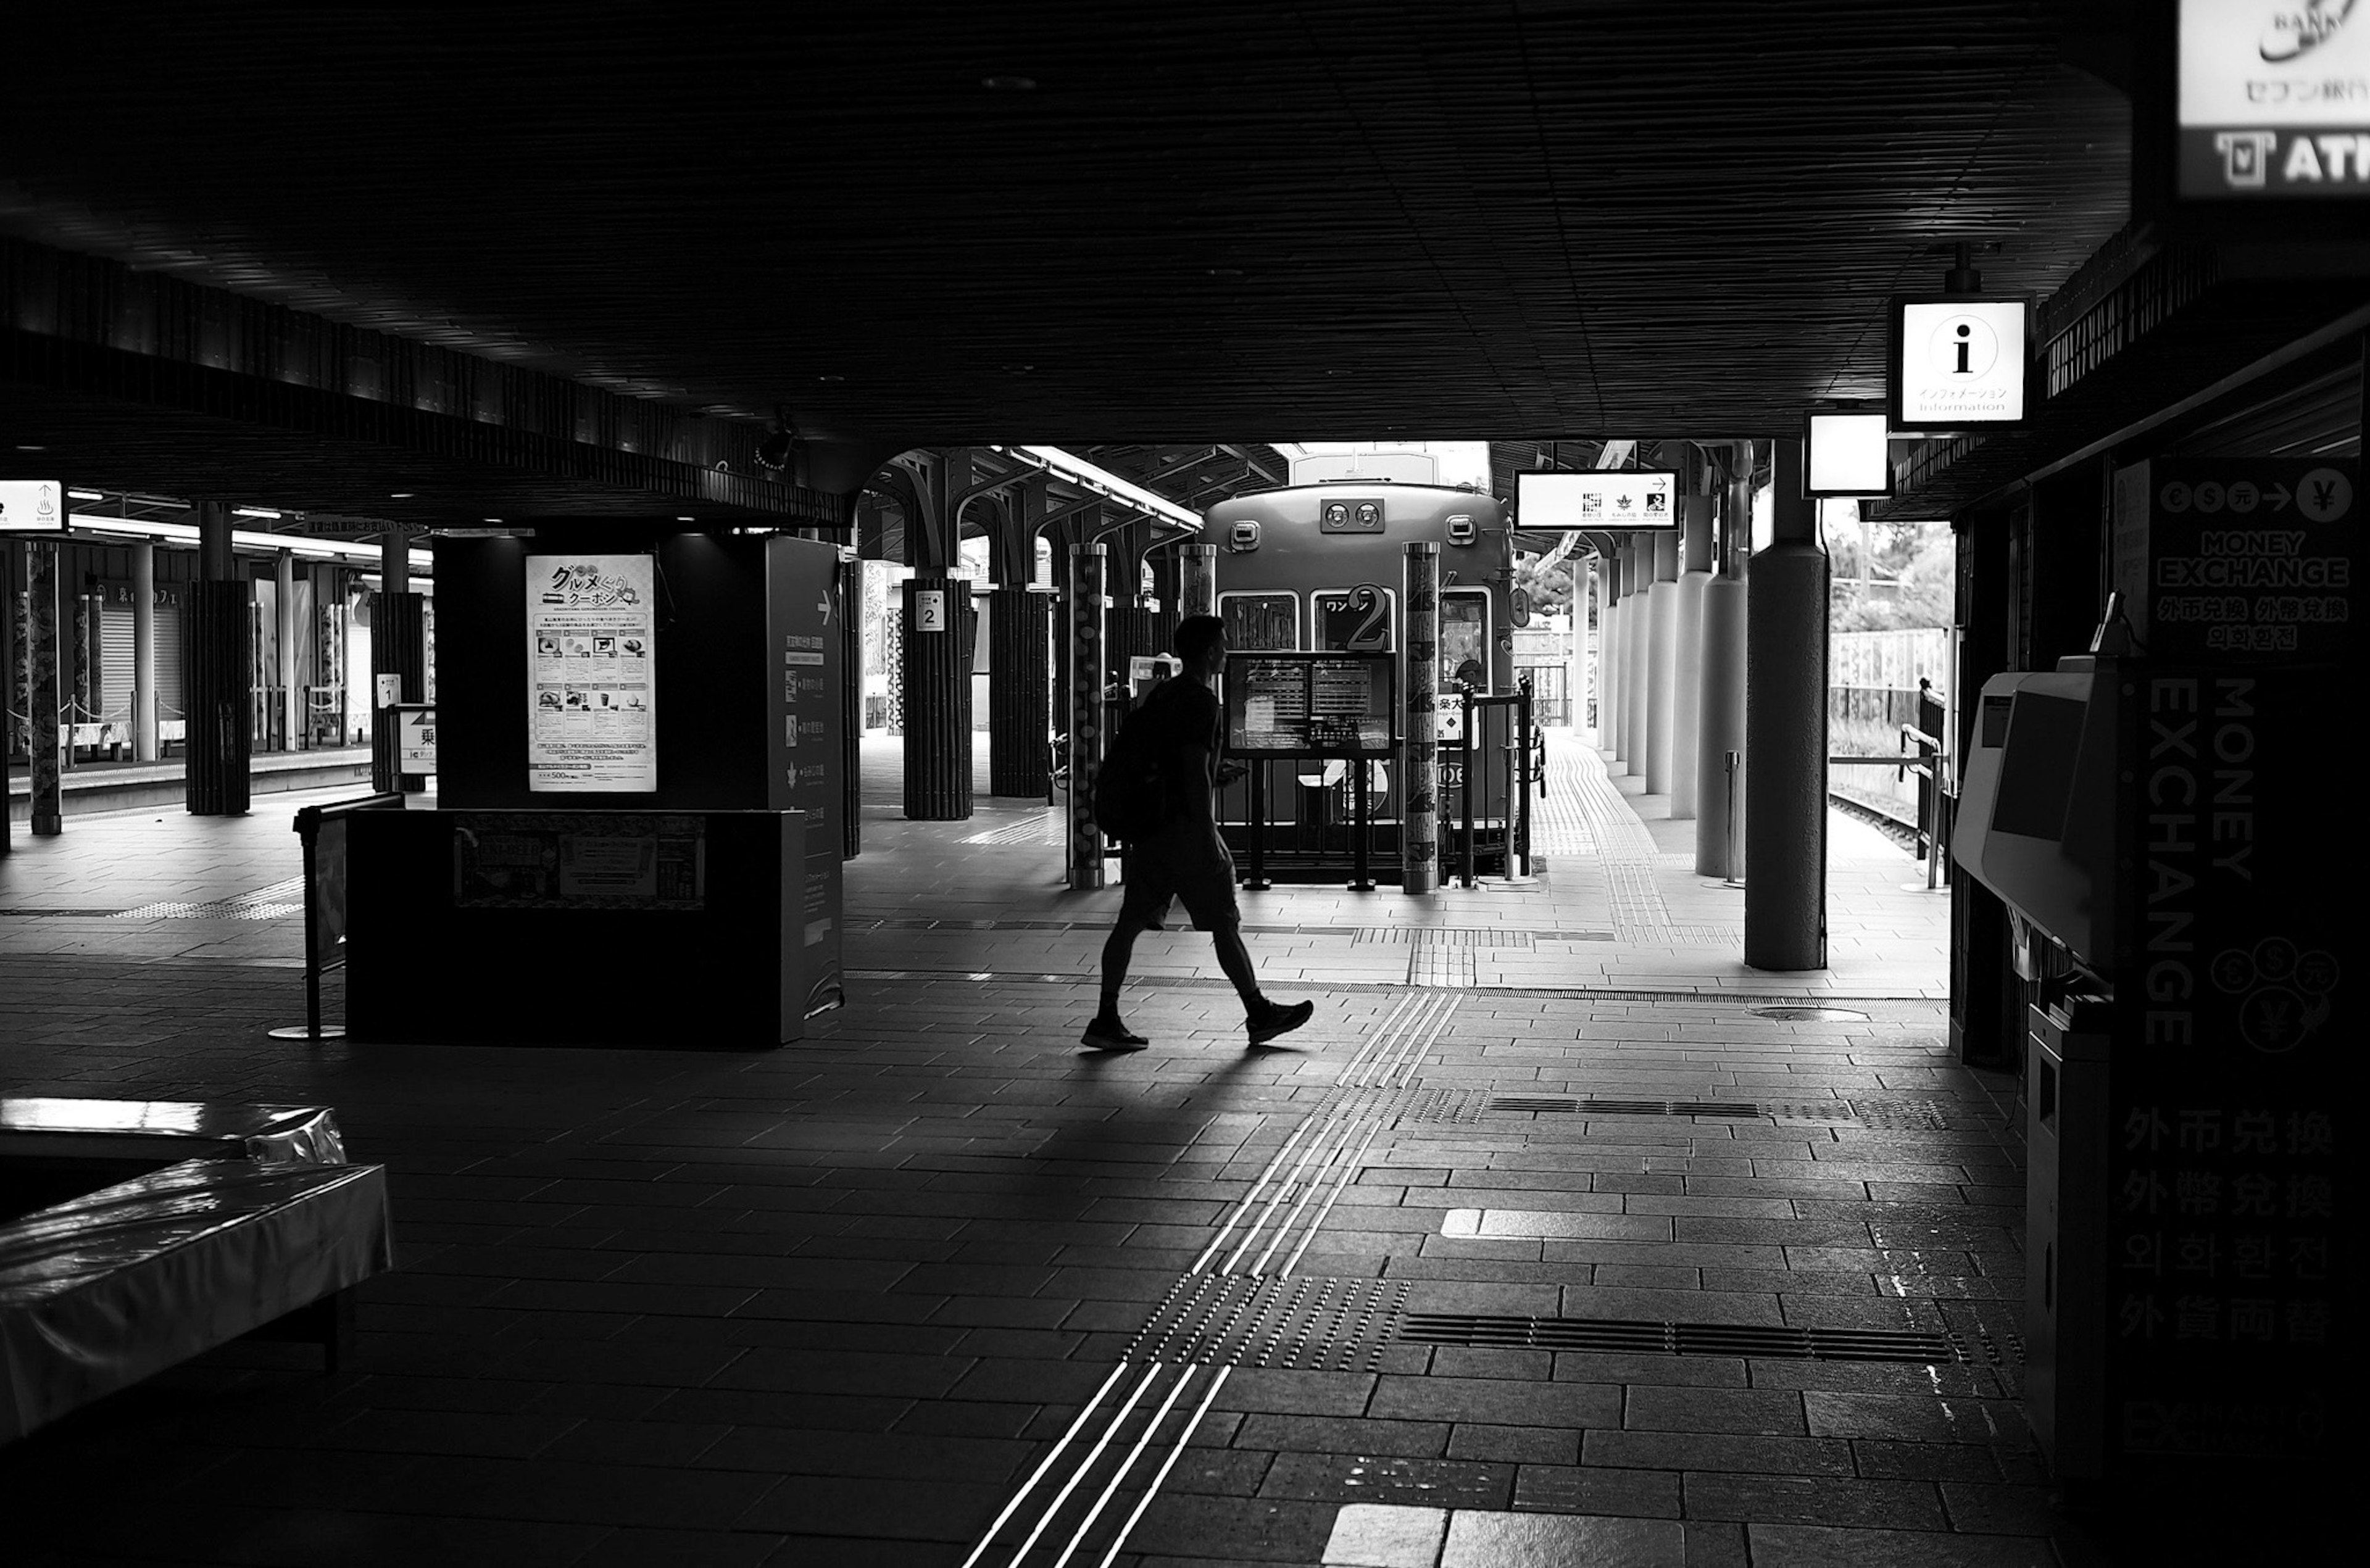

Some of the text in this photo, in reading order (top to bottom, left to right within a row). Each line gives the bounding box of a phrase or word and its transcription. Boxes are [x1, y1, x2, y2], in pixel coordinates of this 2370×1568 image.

[1919, 388, 2007, 399] インフォメーション
[1919, 402, 2005, 412] Information
[2201, 530, 2307, 555] MONEY
[2158, 558, 2351, 587] EXCHANGE
[569, 592, 616, 604] クーポン
[1326, 600, 1369, 613] ワンン
[924, 609, 934, 623] 2
[385, 689, 391, 700] 1
[2212, 678, 2257, 882] MONEY
[2145, 678, 2199, 1045] EXCHANGE
[2121, 1230, 2329, 1282] 외화환전
[2117, 1294, 2332, 1345] 外貨両替
